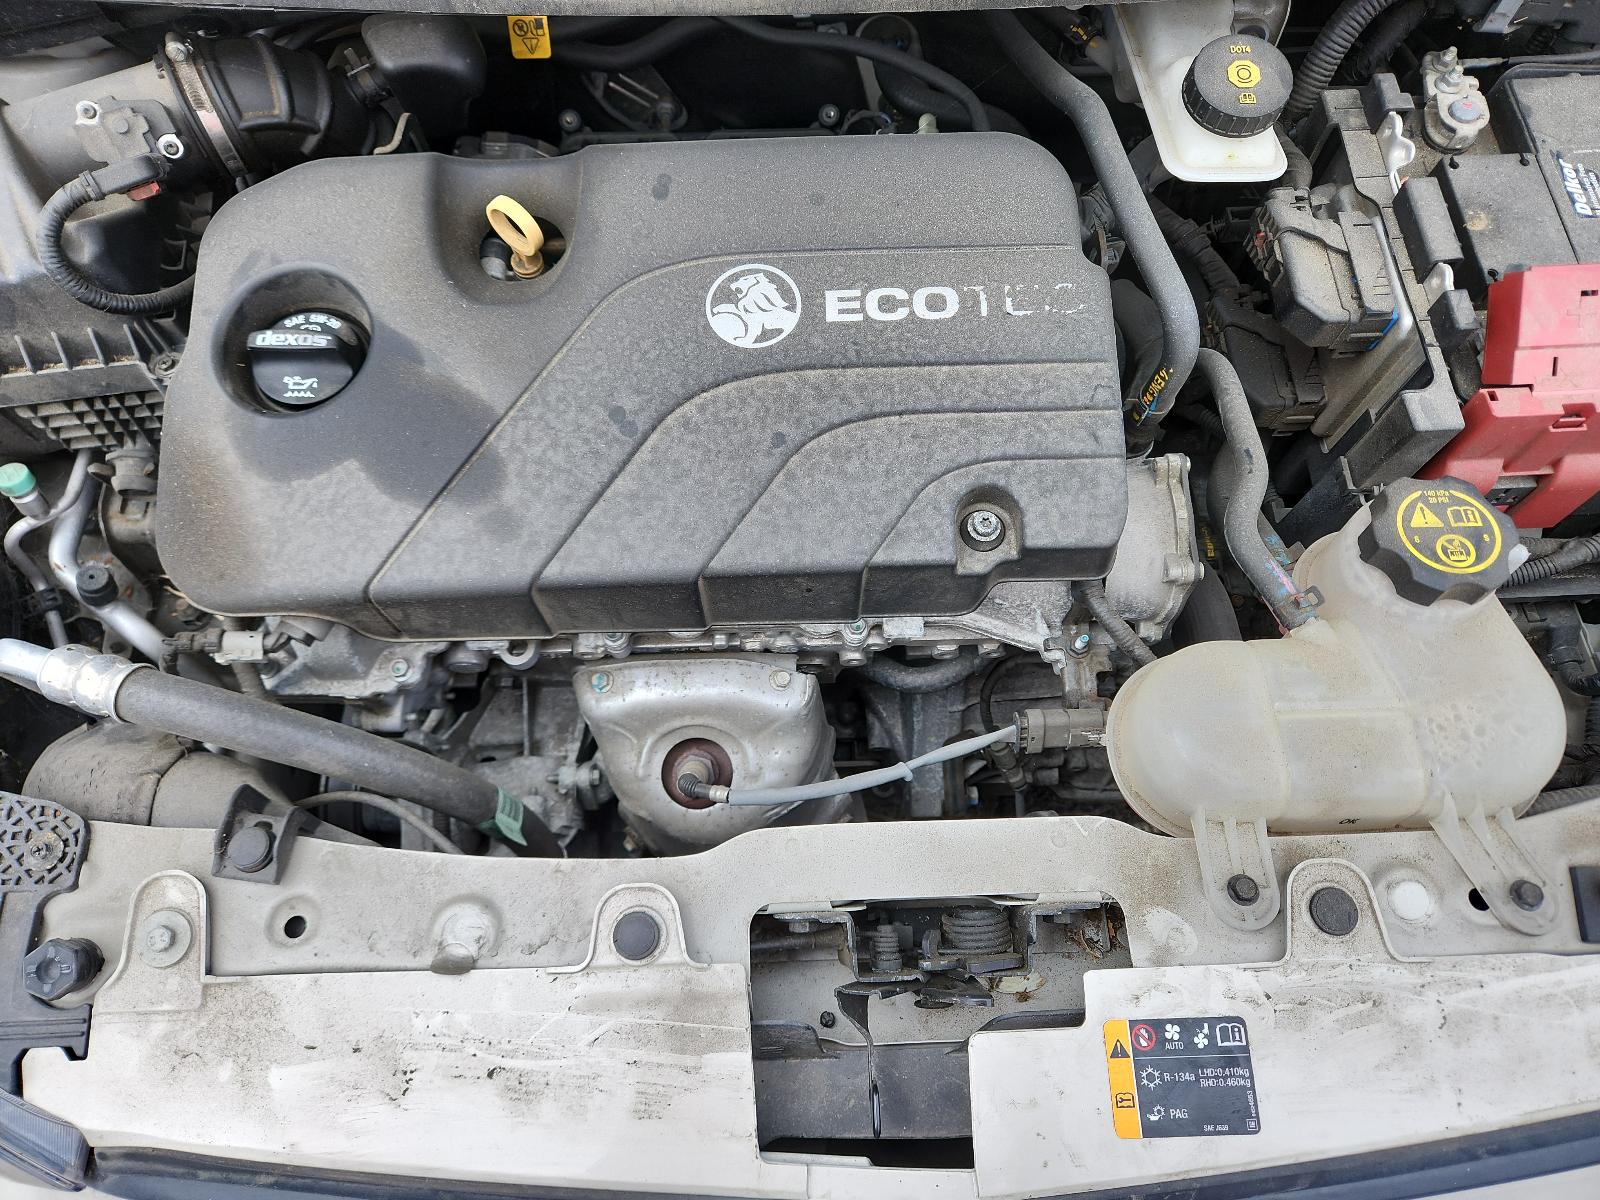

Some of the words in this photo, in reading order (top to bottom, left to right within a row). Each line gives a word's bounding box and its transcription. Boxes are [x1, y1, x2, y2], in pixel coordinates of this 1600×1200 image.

[1559, 158, 1593, 216] Delkor
[256, 331, 329, 346] dexos
[1165, 1042, 1184, 1050] AUTO
[1164, 1072, 1196, 1082] R-134a
[1199, 1067, 1249, 1078] LHD:0.410kg
[1200, 1078, 1251, 1088] RHD:0.460kg
[1170, 1108, 1188, 1119] PAG
[1203, 1124, 1214, 1132] SAE
